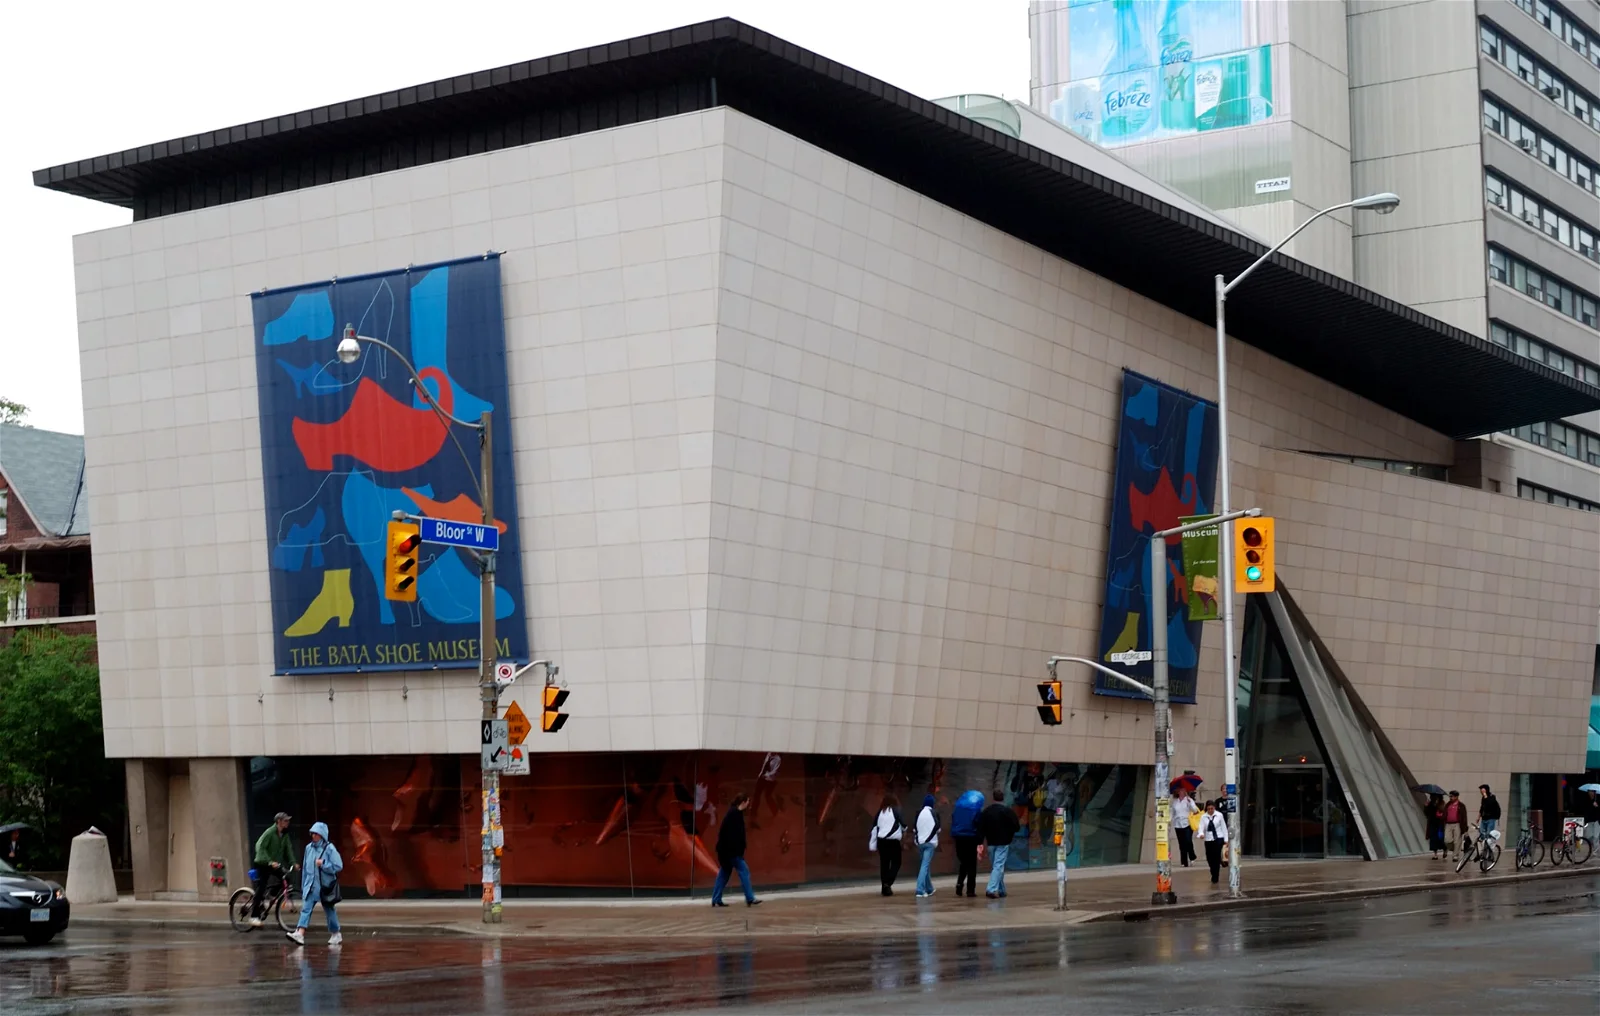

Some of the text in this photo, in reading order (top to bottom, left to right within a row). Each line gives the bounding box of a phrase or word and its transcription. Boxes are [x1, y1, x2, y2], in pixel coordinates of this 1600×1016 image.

[1257, 180, 1288, 189] TITAN
[436, 521, 485, 543] Bloor St W
[1182, 529, 1219, 539] Museum
[290, 638, 511, 667] THE BATA SHOE MUSEM
[1121, 652, 1141, 661] GEORGE
